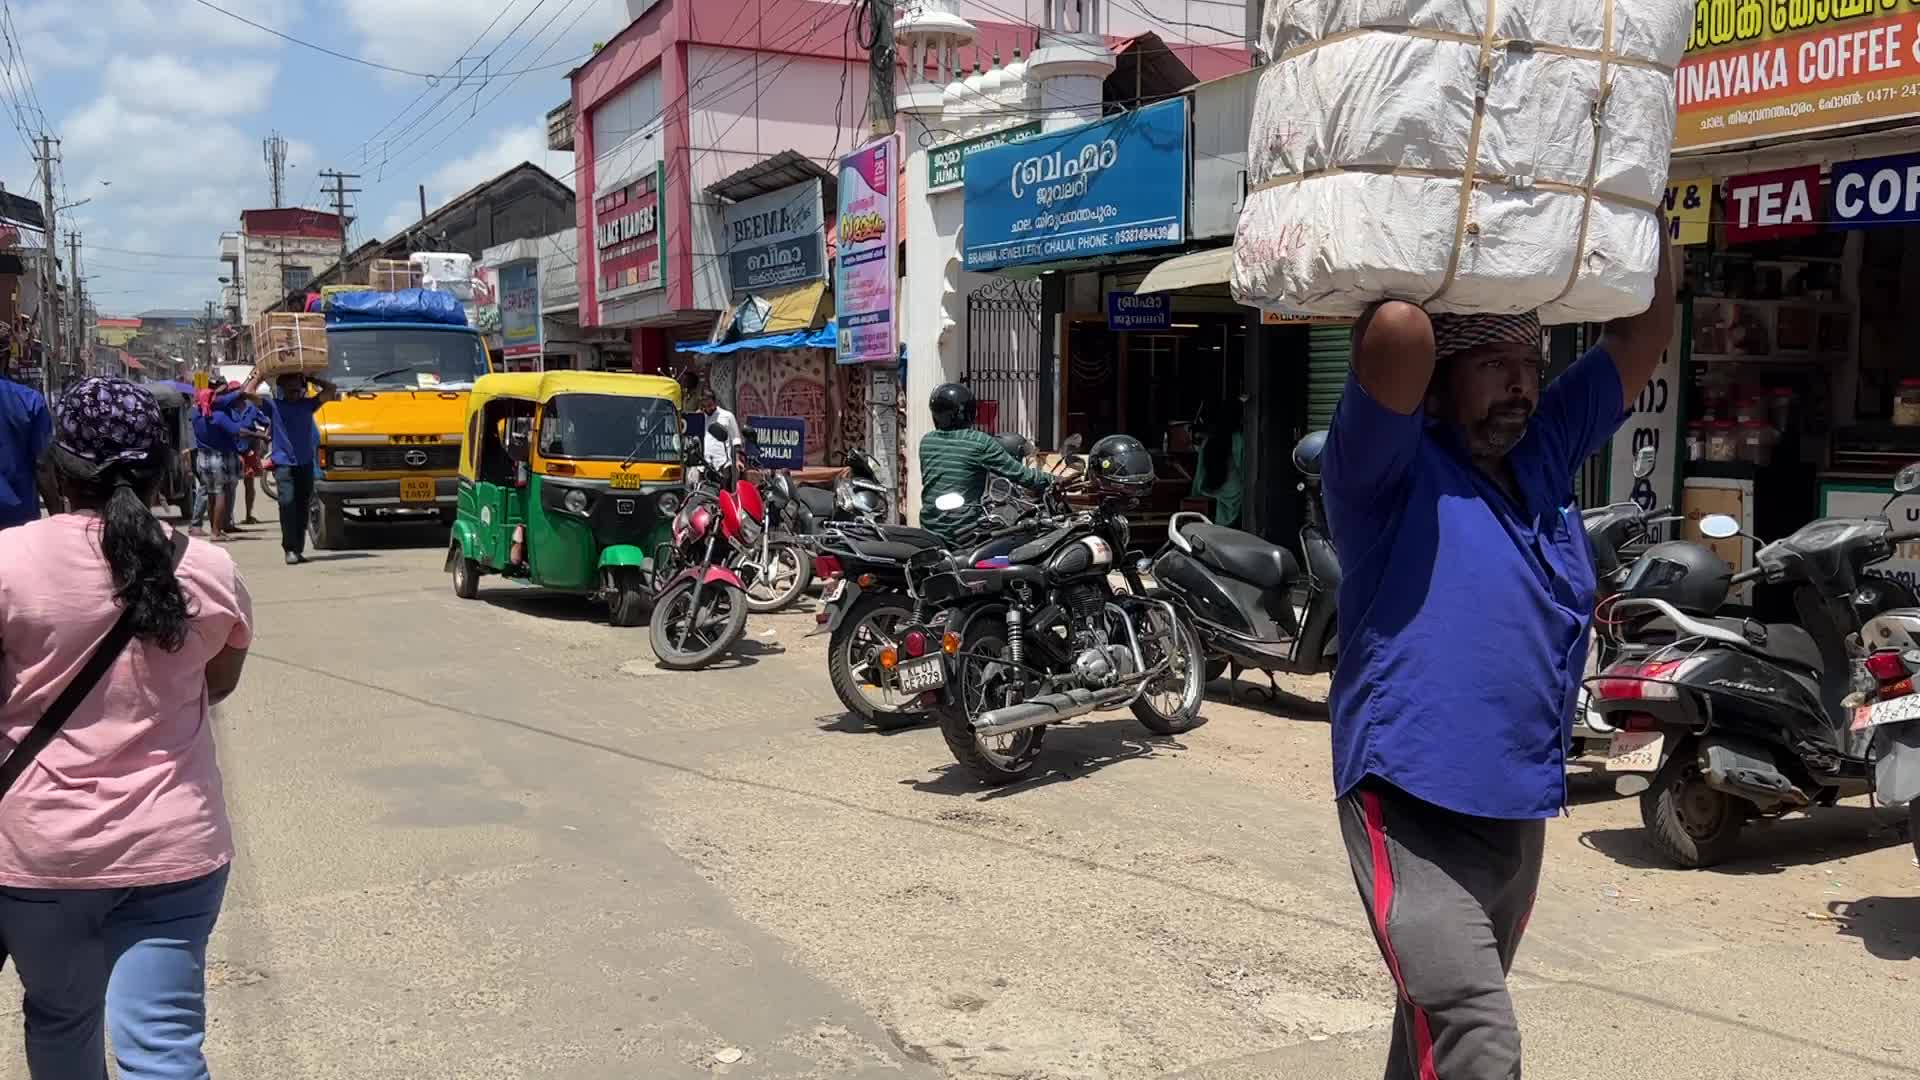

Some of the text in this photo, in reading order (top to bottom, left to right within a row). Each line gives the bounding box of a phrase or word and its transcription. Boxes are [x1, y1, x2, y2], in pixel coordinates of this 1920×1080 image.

[1673, 48, 1789, 105] INAYAKA
[1798, 24, 1902, 84] COFFEE
[934, 166, 960, 185] JUMA
[1733, 179, 1813, 229] TEA
[733, 207, 789, 241] BEEMA
[1078, 236, 1107, 250] PHONE
[772, 428, 800, 446] MASJID
[759, 446, 792, 460] CHALAI
